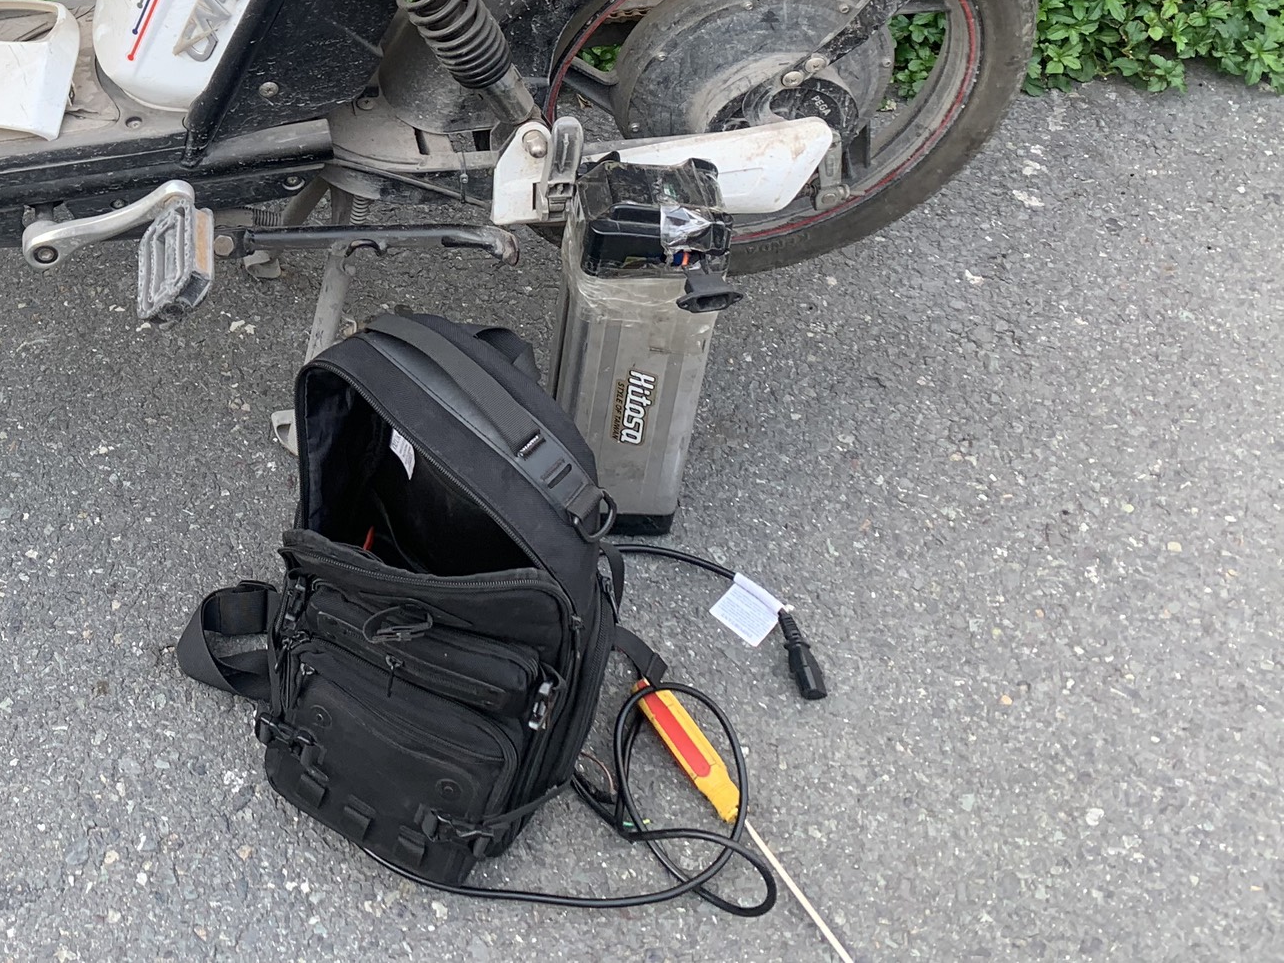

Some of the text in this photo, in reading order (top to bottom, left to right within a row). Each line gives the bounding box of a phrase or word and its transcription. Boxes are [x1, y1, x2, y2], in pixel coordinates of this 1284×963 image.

[811, 95, 832, 116] PEGA
[615, 381, 625, 404] STYLE
[611, 415, 622, 441] TAIWAN
